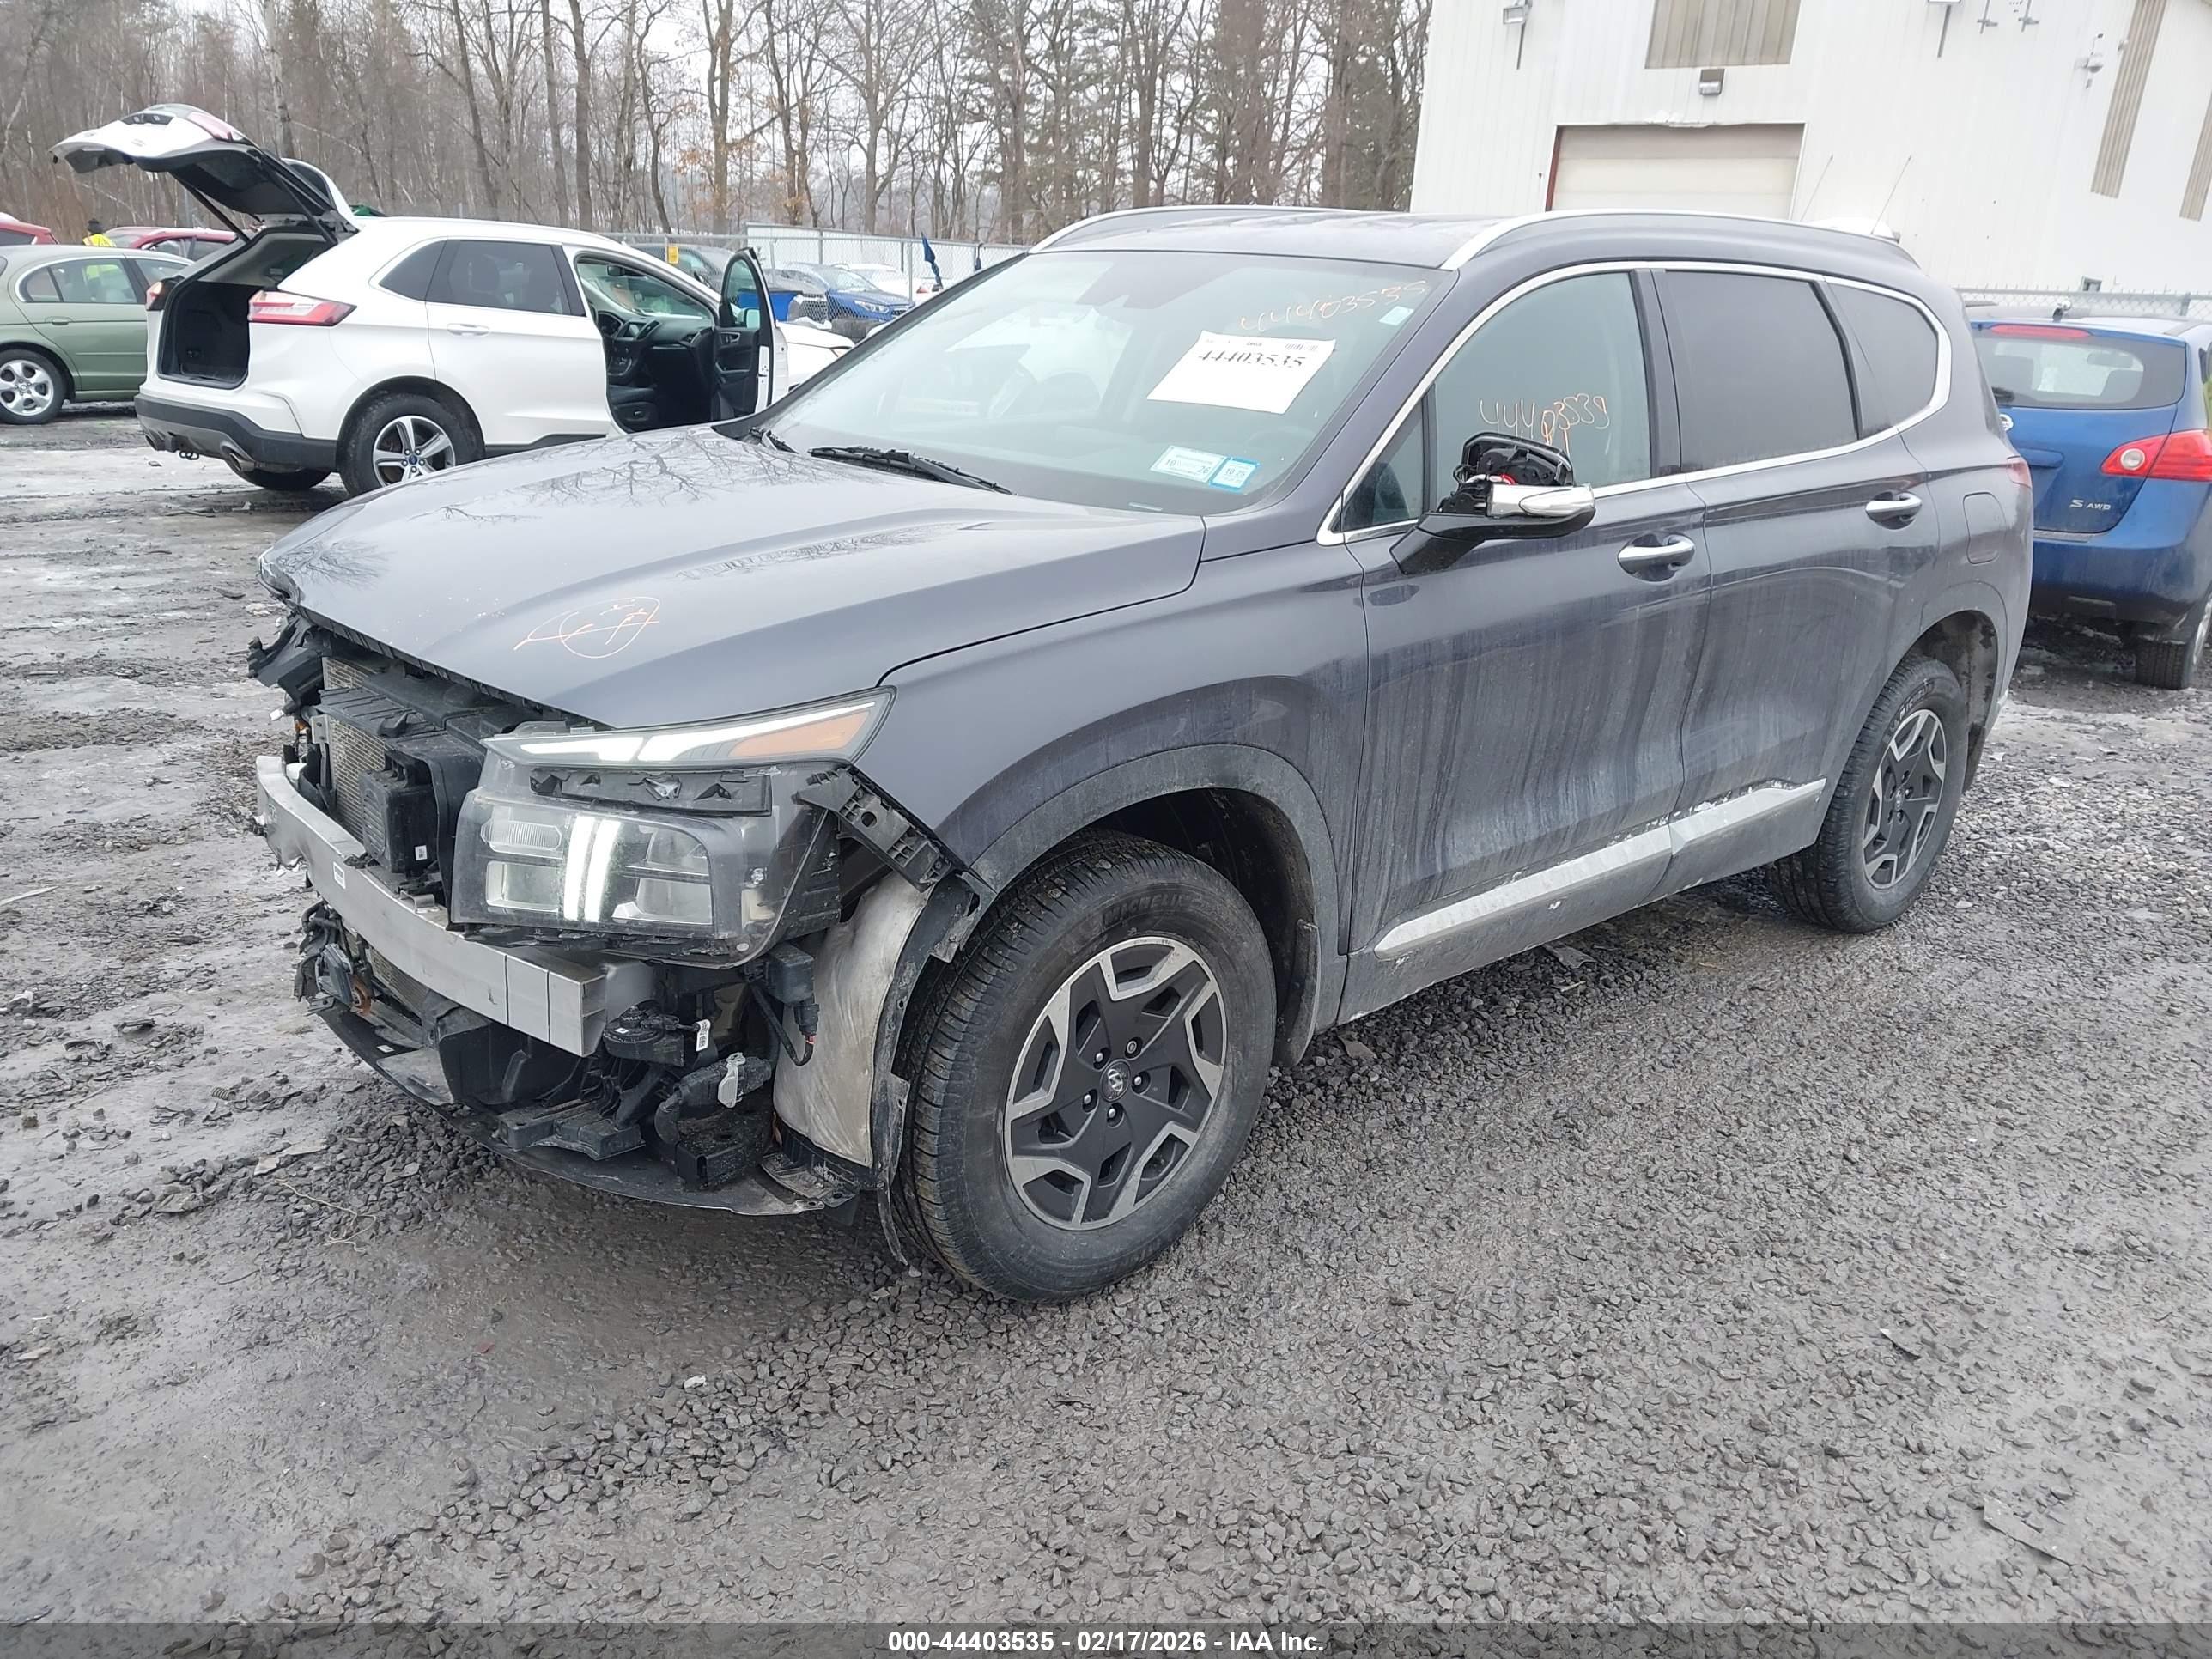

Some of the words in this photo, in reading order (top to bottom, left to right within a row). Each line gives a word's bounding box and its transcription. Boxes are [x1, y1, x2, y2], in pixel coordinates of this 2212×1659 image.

[1241, 281, 1425, 331] 44403535
[1199, 350, 1306, 368] 44403535
[2069, 499, 2084, 508] S
